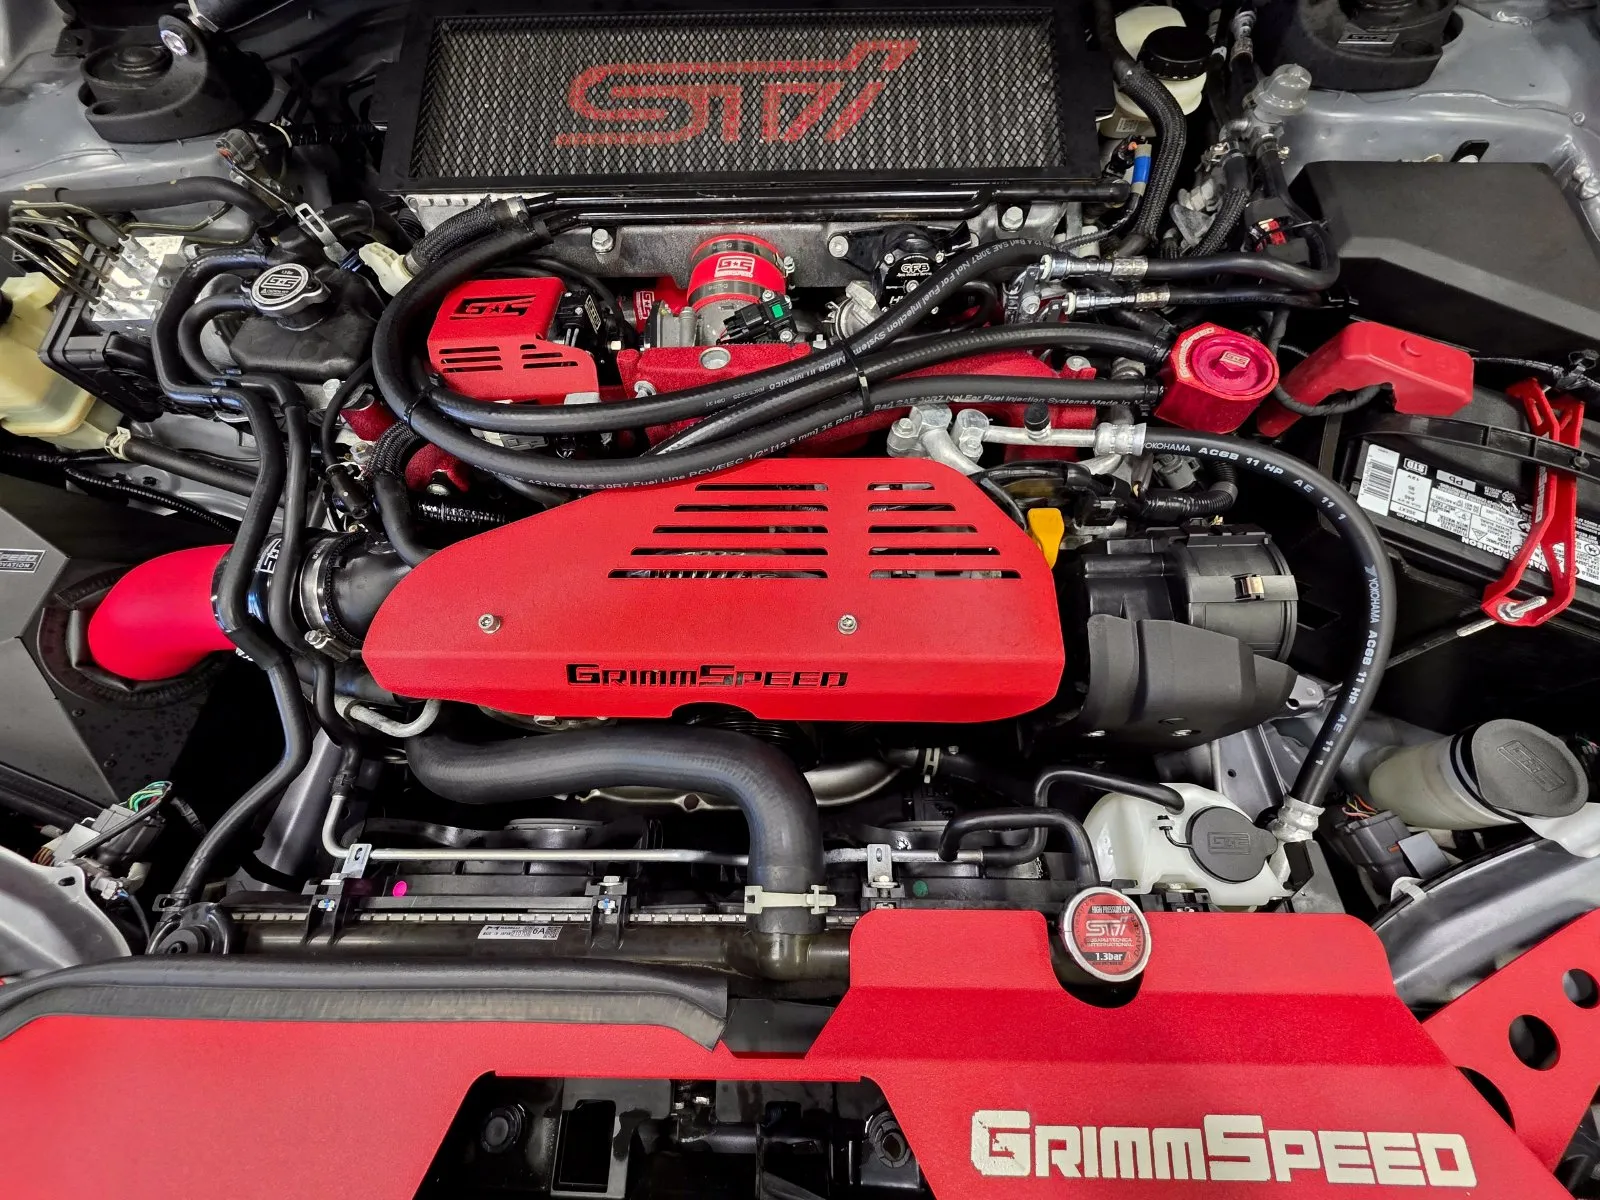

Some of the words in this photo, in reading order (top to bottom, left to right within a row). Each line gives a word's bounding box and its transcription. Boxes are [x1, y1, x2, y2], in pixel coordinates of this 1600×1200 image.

[992, 241, 1009, 252] SAE
[971, 247, 993, 265] 30R7
[955, 260, 972, 275] Not
[941, 270, 958, 288] For
[924, 284, 941, 302] Fuel
[886, 297, 926, 333] Injection
[818, 354, 846, 372] Made
[633, 479, 658, 487] Fuel
[661, 475, 686, 483] Line
[689, 457, 744, 478] PCV/EEC
[1006, 395, 1046, 403] Injection
[1046, 397, 1088, 405] Systems
[1246, 457, 1260, 467] 11
[1264, 463, 1284, 475] HP
[1293, 478, 1316, 493] AE
[1320, 496, 1335, 508] 11
[1448, 476, 1464, 486] Pb
[1368, 577, 1381, 624] YOKOHAMA
[1357, 671, 1368, 685] 11
[1349, 687, 1361, 705] HP
[1333, 713, 1348, 733] AE
[1322, 740, 1334, 753] 11
[533, 927, 545, 935] 6A
[1095, 952, 1123, 960] 1.3bar
